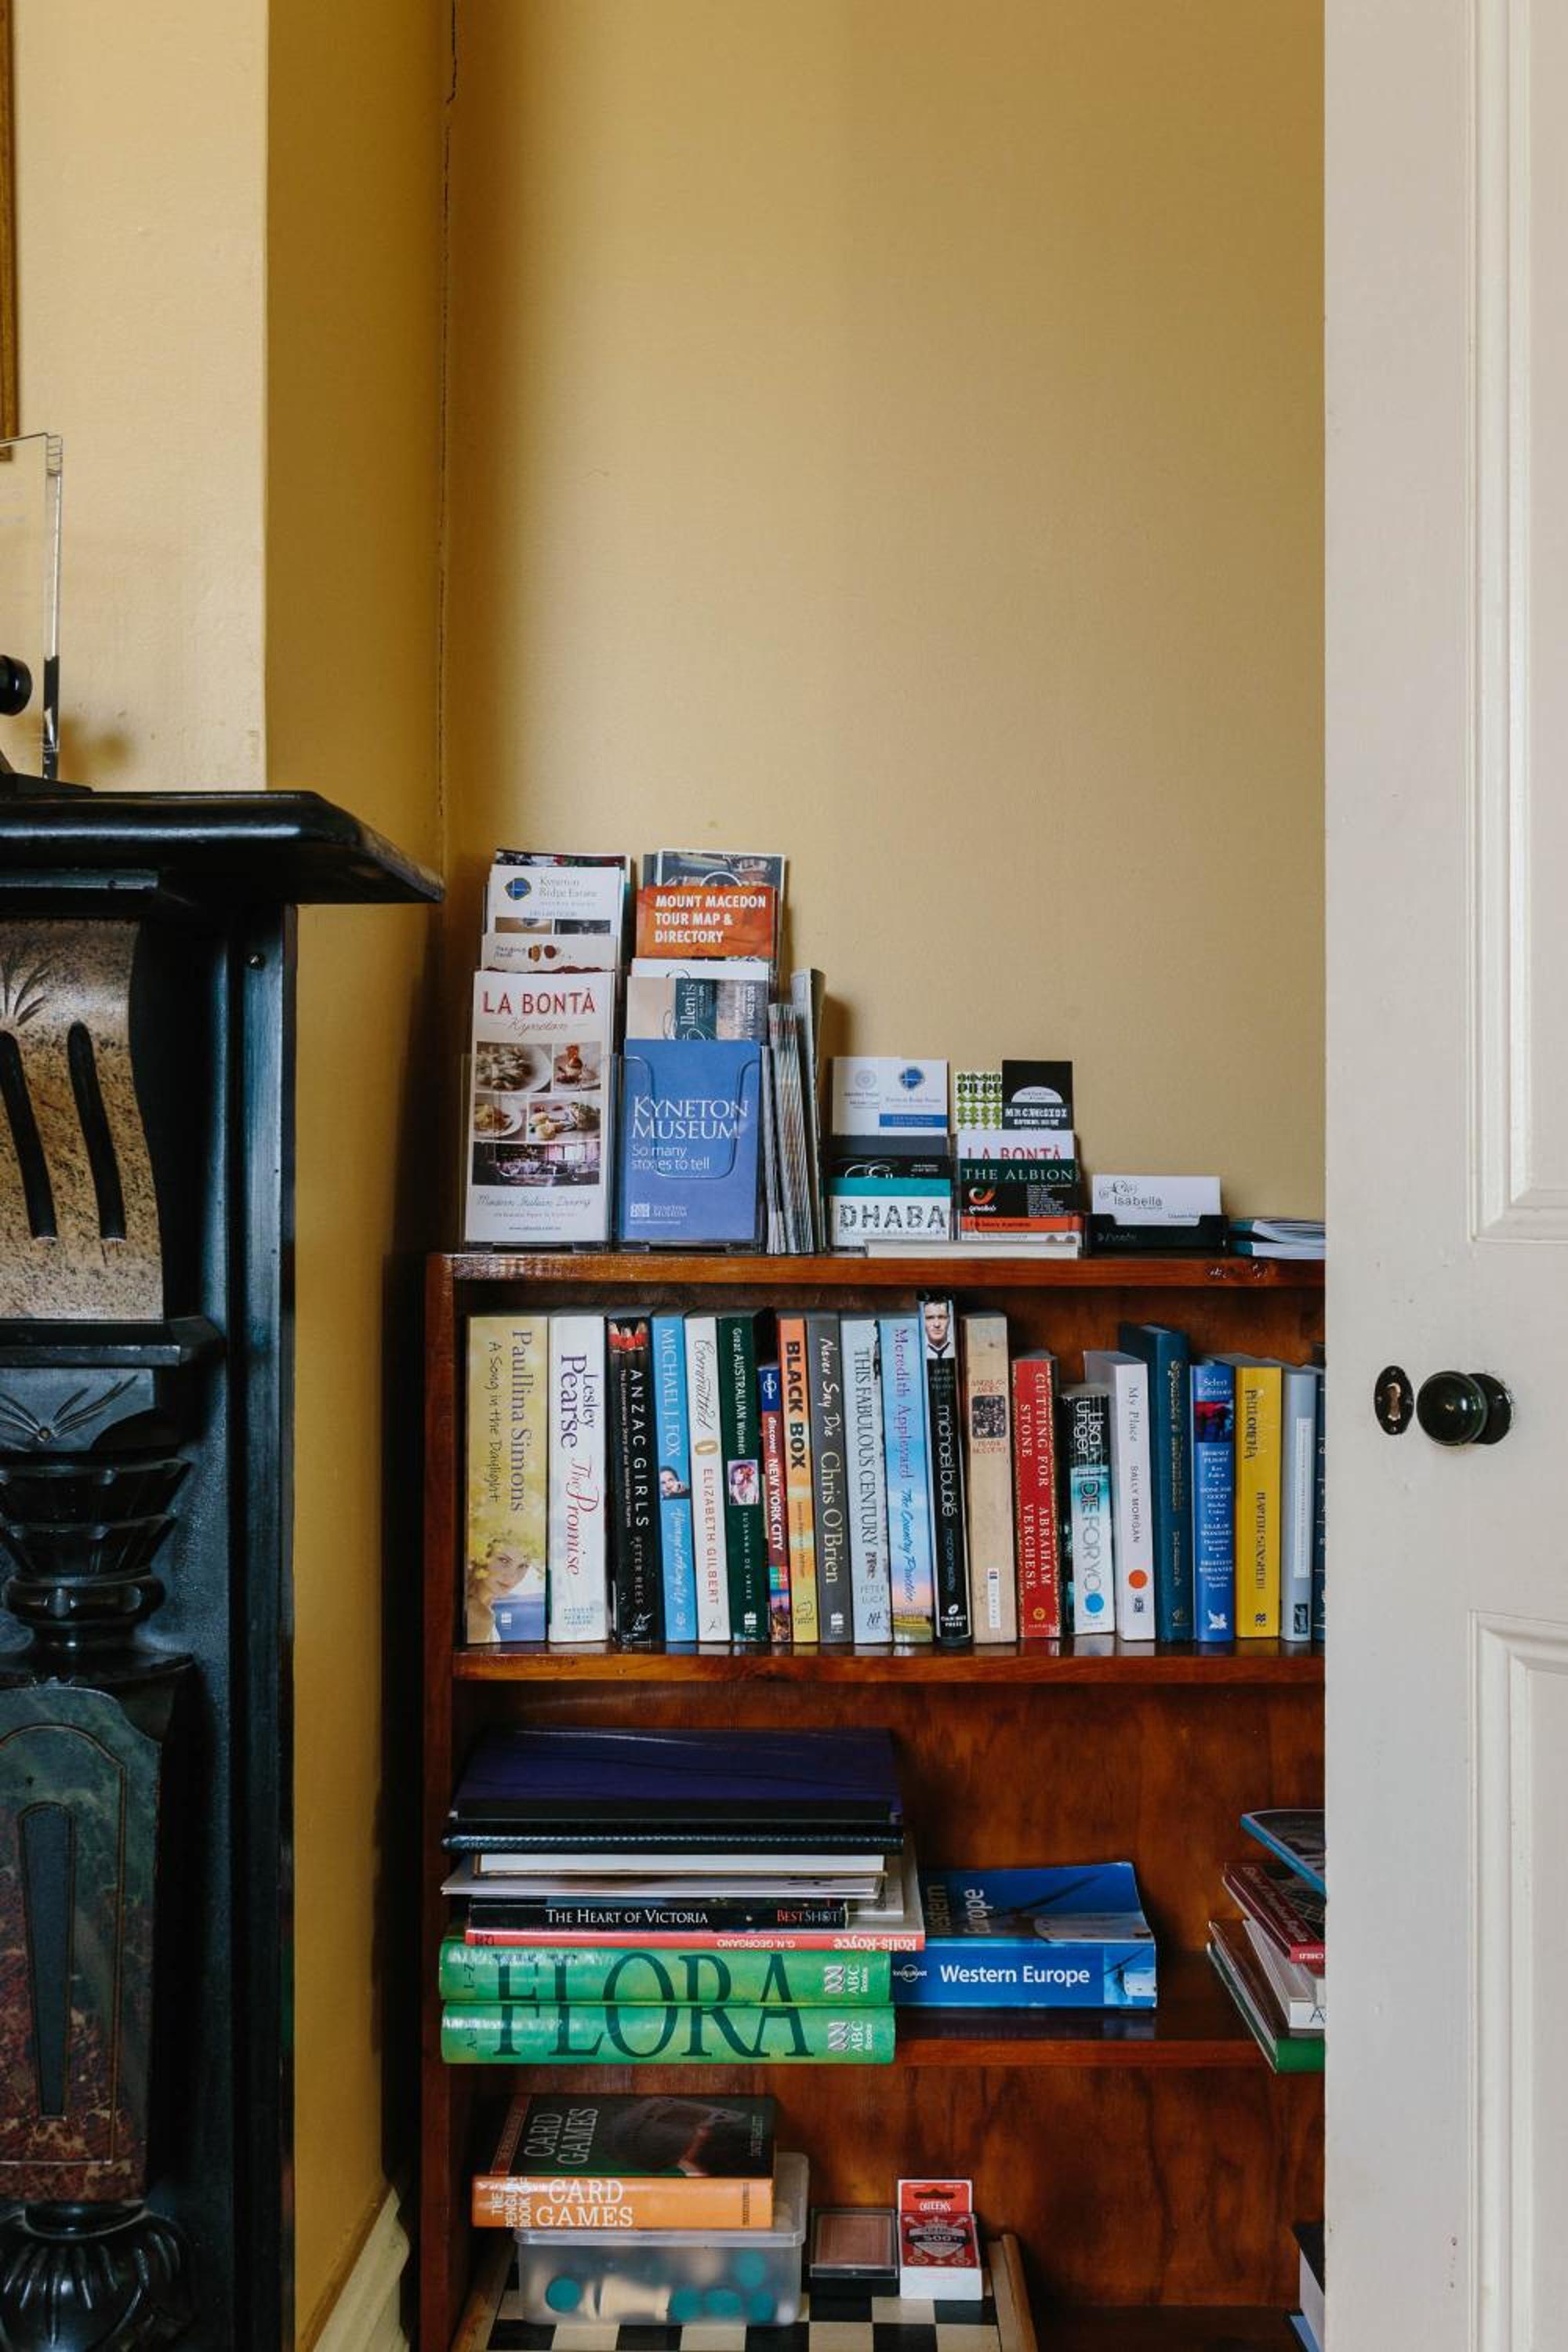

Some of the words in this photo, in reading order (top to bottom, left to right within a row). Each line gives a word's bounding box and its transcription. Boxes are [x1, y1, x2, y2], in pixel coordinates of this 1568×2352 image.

[655, 895, 702, 908] MOUNT
[705, 895, 767, 908] MACEDON
[655, 912, 690, 926] TOUR
[691, 912, 721, 926] MAP
[723, 913, 734, 926] &
[654, 930, 725, 944] DIRECTORY
[482, 990, 512, 1015] LA
[522, 987, 597, 1014] BONTÀ
[633, 1095, 749, 1119] KYNETON
[632, 1118, 741, 1139] MUSEUM
[632, 1144, 649, 1157] So
[652, 1145, 688, 1160] many
[674, 1159, 688, 1170] to
[691, 1157, 710, 1170] tell
[963, 1168, 998, 1180] THE
[1004, 1168, 1073, 1180] ALBION
[840, 1203, 946, 1229] DHABA
[1113, 1195, 1163, 1207] Isabella
[489, 1341, 502, 1352] A
[731, 1327, 743, 1352] Great
[818, 1338, 837, 1374] Never
[484, 1356, 503, 1390] Song
[510, 1330, 533, 1421] Paullina
[660, 1328, 677, 1408] MICHAEL
[786, 1341, 803, 1413] BLACK
[854, 1348, 871, 1383] THIS
[894, 1329, 910, 1397] Meredith
[489, 1395, 500, 1406] in
[560, 1354, 586, 1449] Pearse
[576, 1374, 601, 1428] Lesley
[693, 1339, 715, 1432] Committed
[733, 1353, 747, 1419] AUSTRALIAN
[818, 1382, 840, 1407] Say
[1127, 1386, 1139, 1406] My
[489, 1408, 502, 1435] the
[630, 1370, 646, 1446] ANZAC
[662, 1410, 677, 1420] J.
[823, 1413, 840, 1437] Die
[1034, 1373, 1047, 1449] CUTTING
[665, 1424, 681, 1456] FOX
[735, 1421, 747, 1454] Women
[768, 1417, 778, 1454] discover
[855, 1387, 876, 1467] FABULOUS
[895, 1404, 914, 1479] Appleyard
[1021, 1404, 1033, 1458] STONE
[1075, 1400, 1090, 1457] Unger
[1088, 1412, 1105, 1446] Lisa
[1128, 1411, 1140, 1442] Place
[789, 1422, 806, 1469] BOX
[485, 1441, 503, 1503] Daylight
[509, 1428, 532, 1512] Simons
[570, 1456, 593, 1489] The
[768, 1457, 779, 1486] NEW
[819, 1451, 841, 1503] Chris
[1038, 1456, 1050, 1486] FOR
[1130, 1465, 1140, 1494] SALLY
[633, 1457, 649, 1526] GIRLS
[703, 1468, 716, 1542] ELIZABETH
[768, 1489, 782, 1522] YORK
[858, 1469, 878, 1547] CENTURY
[901, 1489, 912, 1508] The
[1080, 1480, 1099, 1515] DIE
[565, 1483, 600, 1575] Promise
[771, 1524, 783, 1550] CITY
[899, 1509, 915, 1553] Country
[1083, 1515, 1099, 1559] FOR
[1131, 1497, 1141, 1544] MORGAN
[633, 1536, 643, 1571] PETER
[822, 1508, 844, 1584] O'Brien
[1023, 1504, 1038, 1591] VERGHESE
[1038, 1506, 1051, 1585] ABRAHAM
[706, 1548, 719, 1606] GILBERT
[903, 1555, 915, 1602] Practice
[545, 1909, 573, 1923] THE
[577, 1909, 621, 1923] HEART
[624, 1911, 642, 1923] OF
[644, 1910, 708, 1924] VICTORIA
[833, 1934, 916, 1951] Rolls-Royce
[848, 1964, 860, 1995] ABC
[939, 1965, 1018, 1983] Western
[1022, 1965, 1091, 1987] Europe
[492, 1951, 815, 2058] FLORA
[851, 2020, 863, 2053] ABC
[524, 2113, 564, 2158] CARD
[556, 2107, 599, 2165] GAMES
[548, 2180, 623, 2205] CARD
[535, 2206, 634, 2227] GAMES
